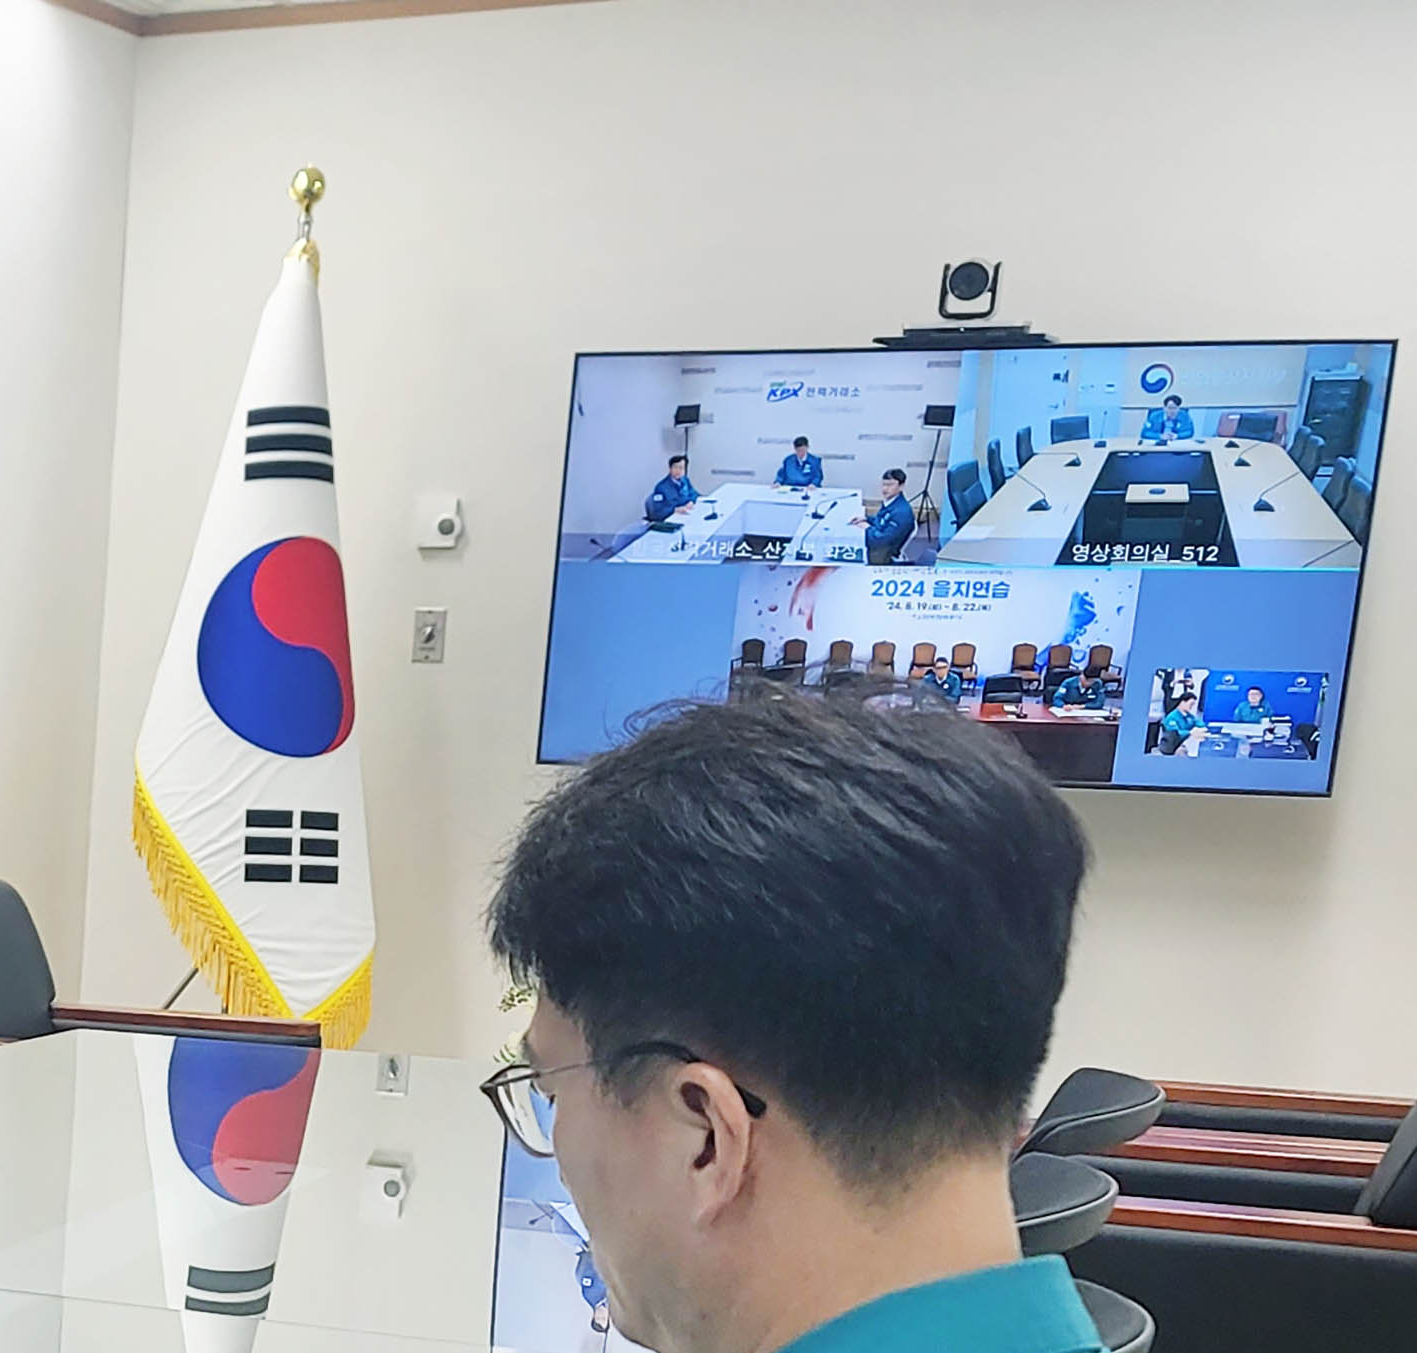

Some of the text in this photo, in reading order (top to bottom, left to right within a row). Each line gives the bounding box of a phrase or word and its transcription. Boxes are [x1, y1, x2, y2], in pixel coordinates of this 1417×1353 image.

[1072, 543, 1219, 563] 영상회의실_512
[871, 579, 1010, 598] 2024 을지연습
